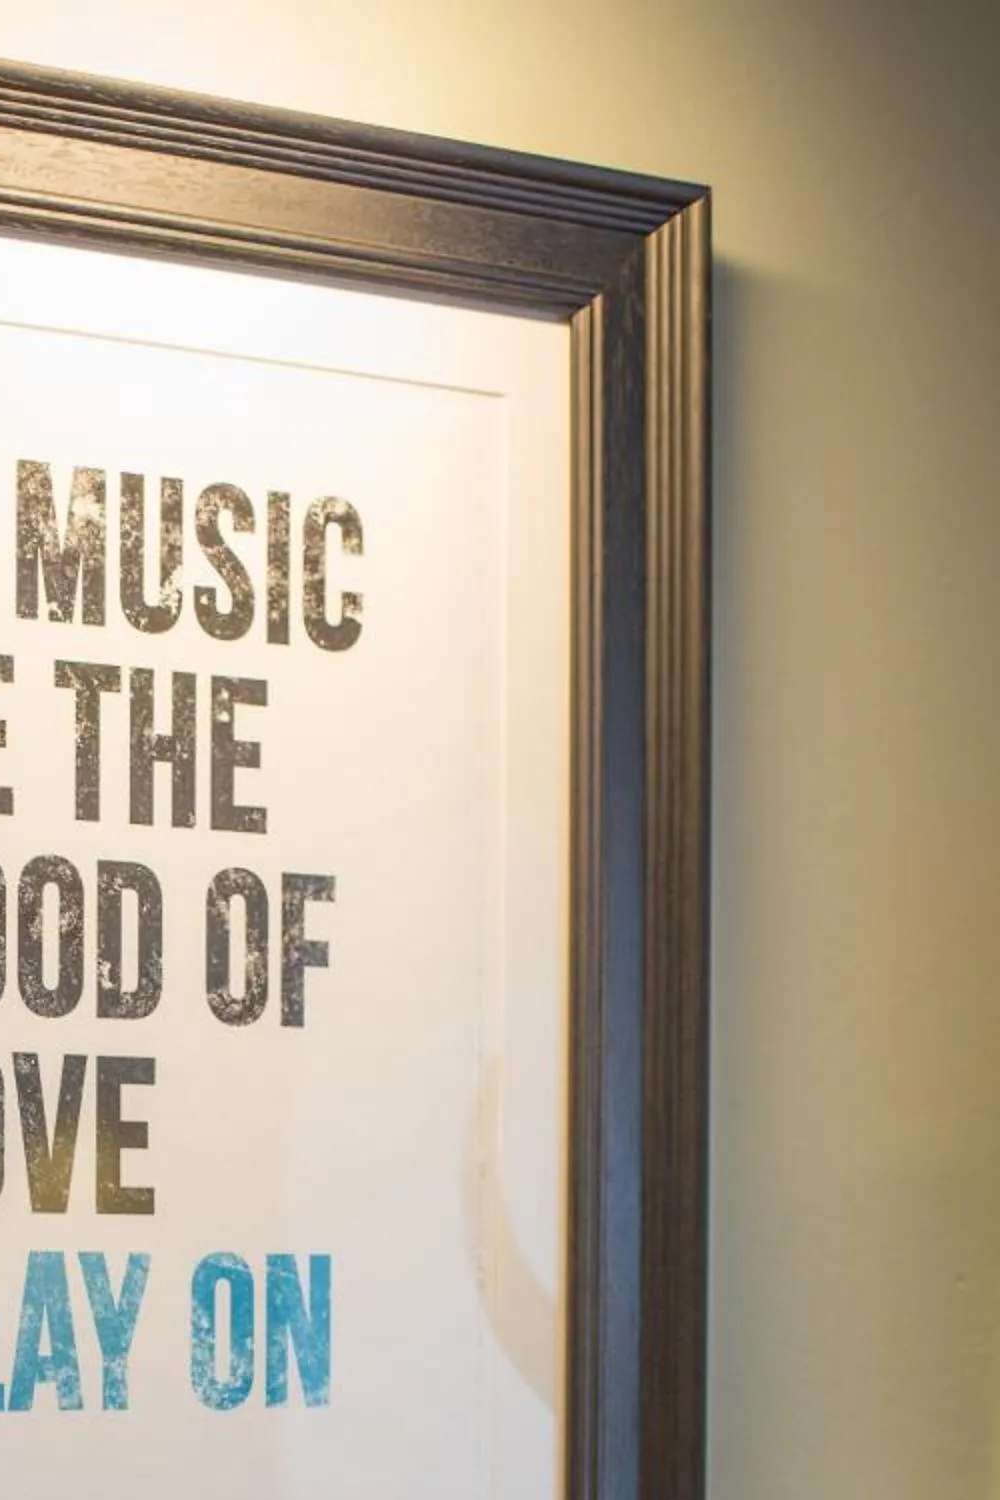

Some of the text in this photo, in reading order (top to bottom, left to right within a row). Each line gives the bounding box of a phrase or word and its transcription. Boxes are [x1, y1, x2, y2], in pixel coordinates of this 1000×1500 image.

[15, 458, 365, 653] MUSIC
[53, 658, 269, 835] THE
[204, 865, 337, 1029] OF
[189, 1251, 333, 1412] ON
